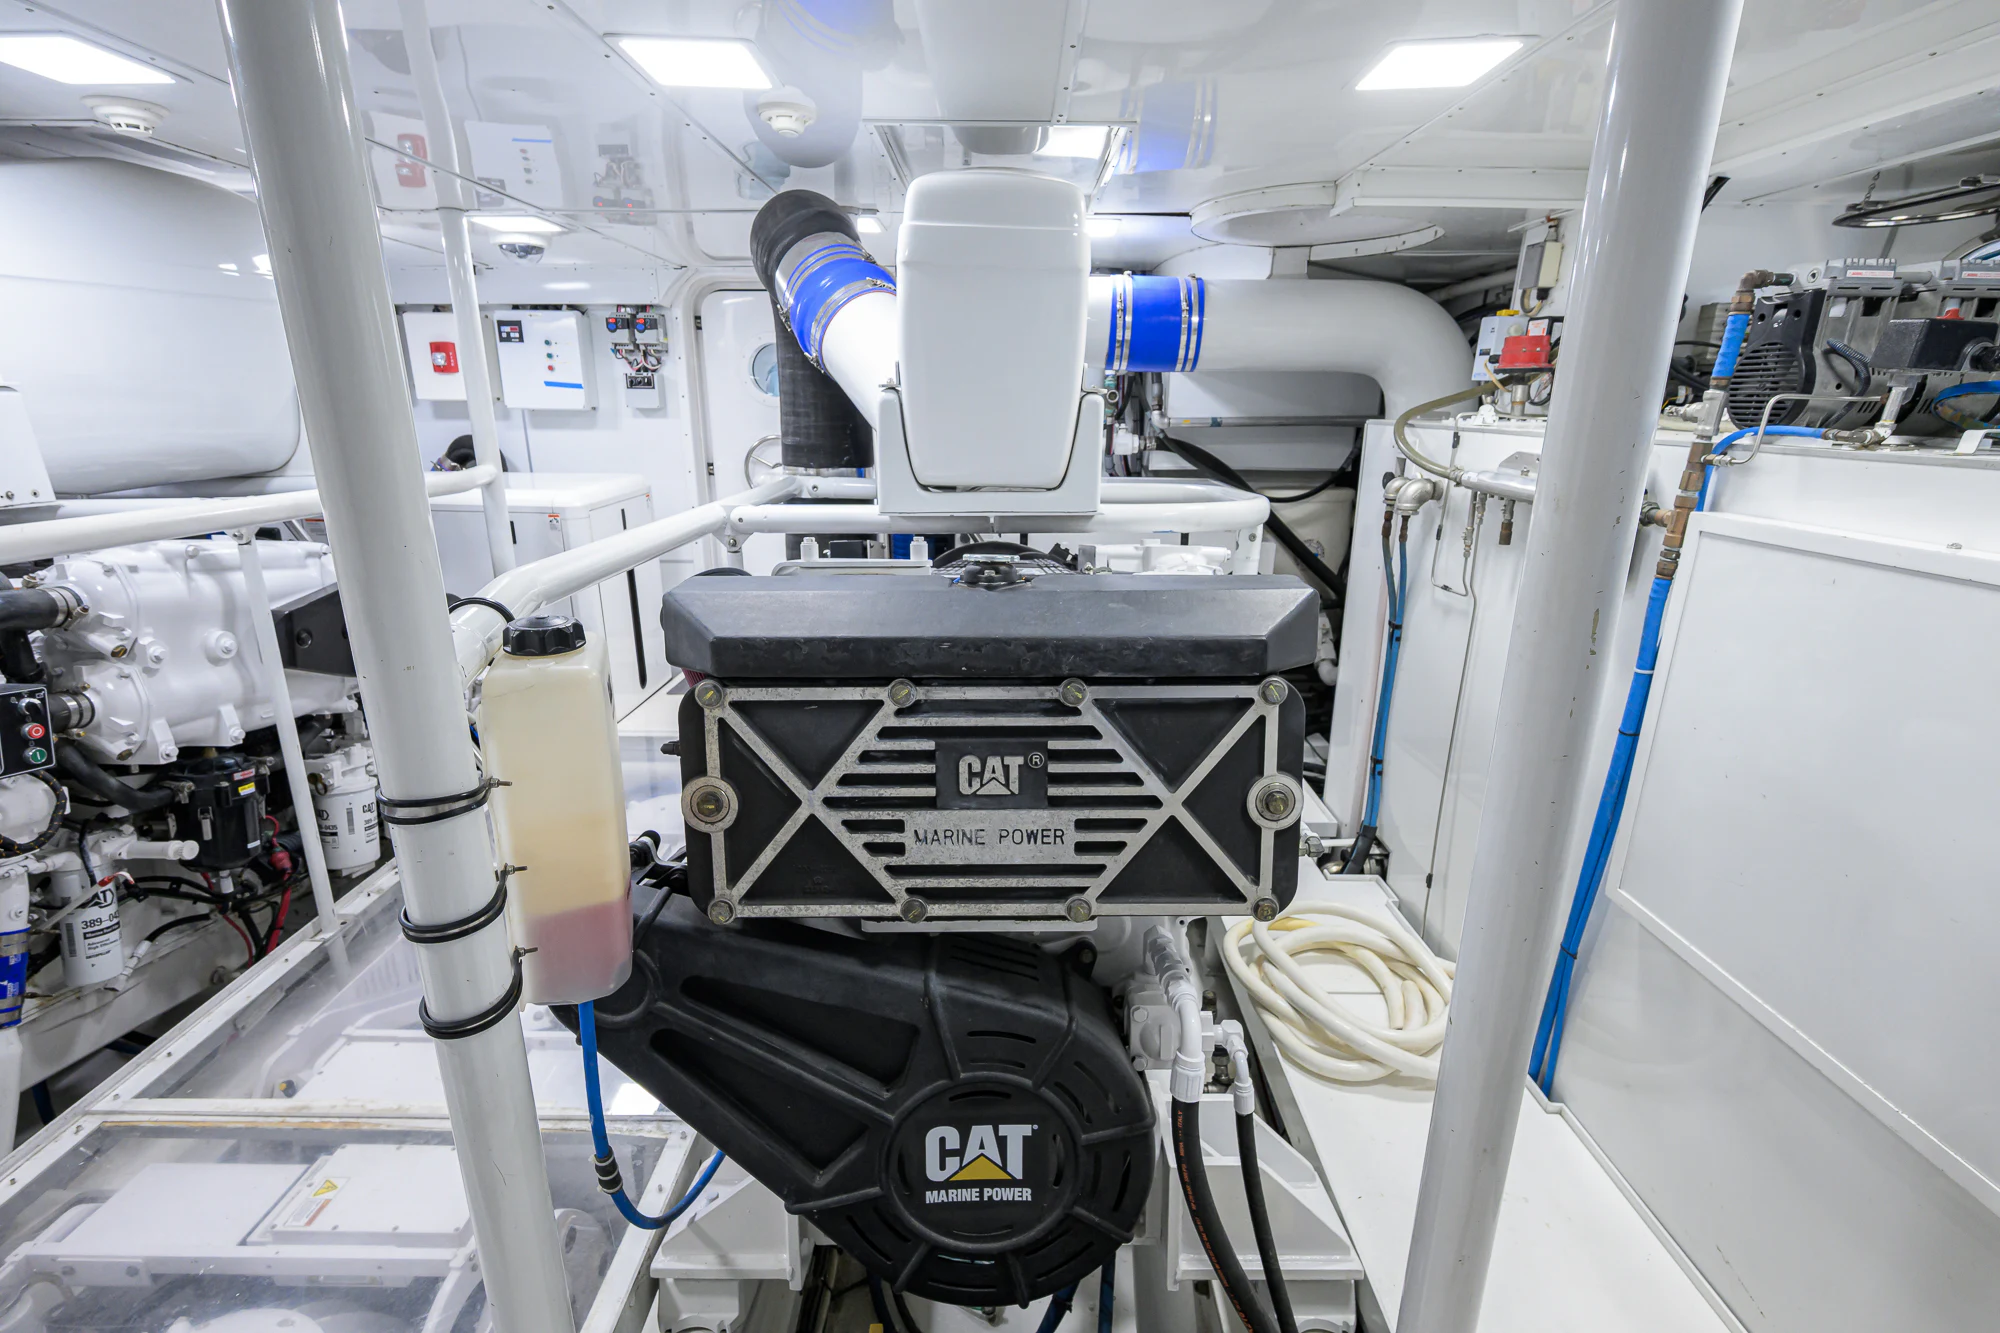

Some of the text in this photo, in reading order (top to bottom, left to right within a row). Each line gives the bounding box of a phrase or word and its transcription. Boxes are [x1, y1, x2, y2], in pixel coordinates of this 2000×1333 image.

[913, 828, 1065, 846] MARINE POWER
[925, 1124, 1032, 1182] CAT
[925, 1187, 1032, 1204] MARINE POWER
